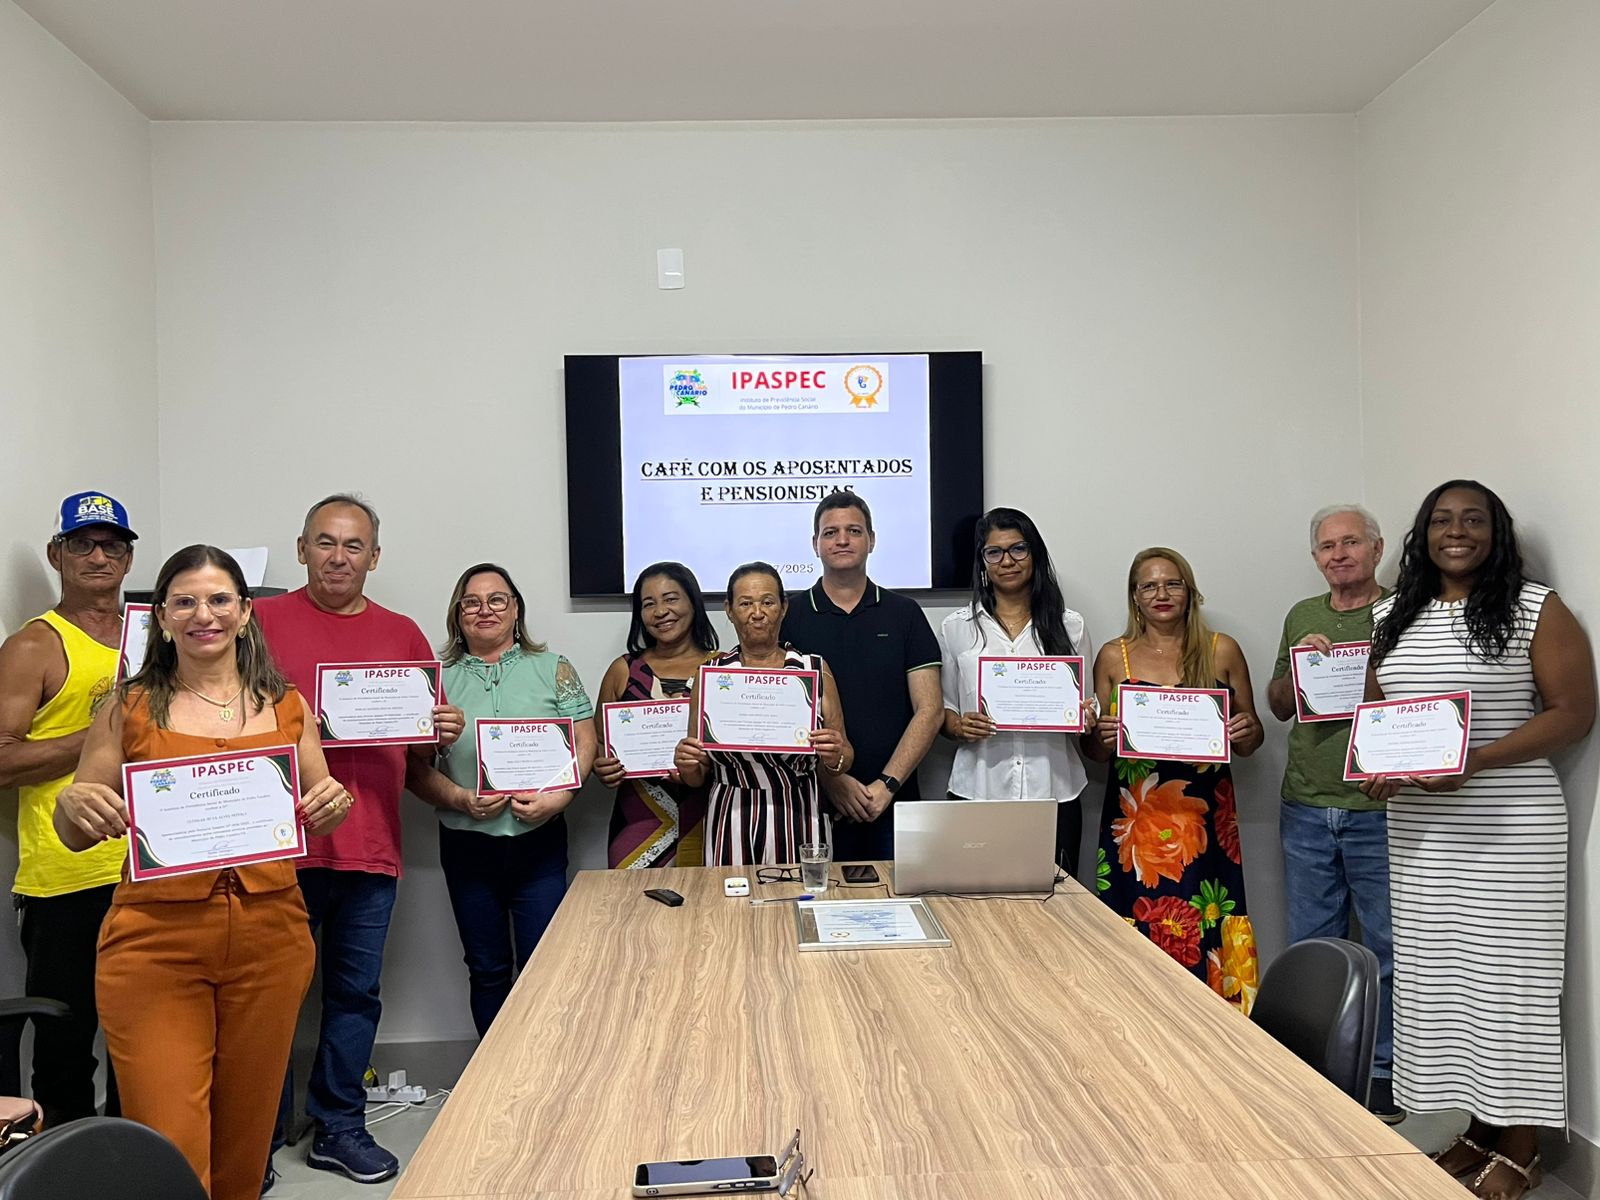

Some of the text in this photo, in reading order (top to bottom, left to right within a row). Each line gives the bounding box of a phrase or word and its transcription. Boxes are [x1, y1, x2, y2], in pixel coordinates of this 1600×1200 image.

[732, 371, 826, 389] IPASPEC
[641, 458, 913, 477] CAFÉ COM OS APOSENTADOS
[701, 487, 714, 501] E
[78, 504, 113, 515] BASE
[1017, 663, 1056, 671] IPASPEC
[364, 669, 410, 678] IPASPEC
[744, 675, 788, 685] IPASPEC
[1159, 694, 1200, 703] IPASPEC
[643, 705, 682, 715] IPASPEC
[1397, 702, 1439, 715] IPASPEC
[511, 725, 548, 733] IPASPEC
[192, 760, 255, 778] IPASPEC
[189, 786, 240, 800] Certificado
